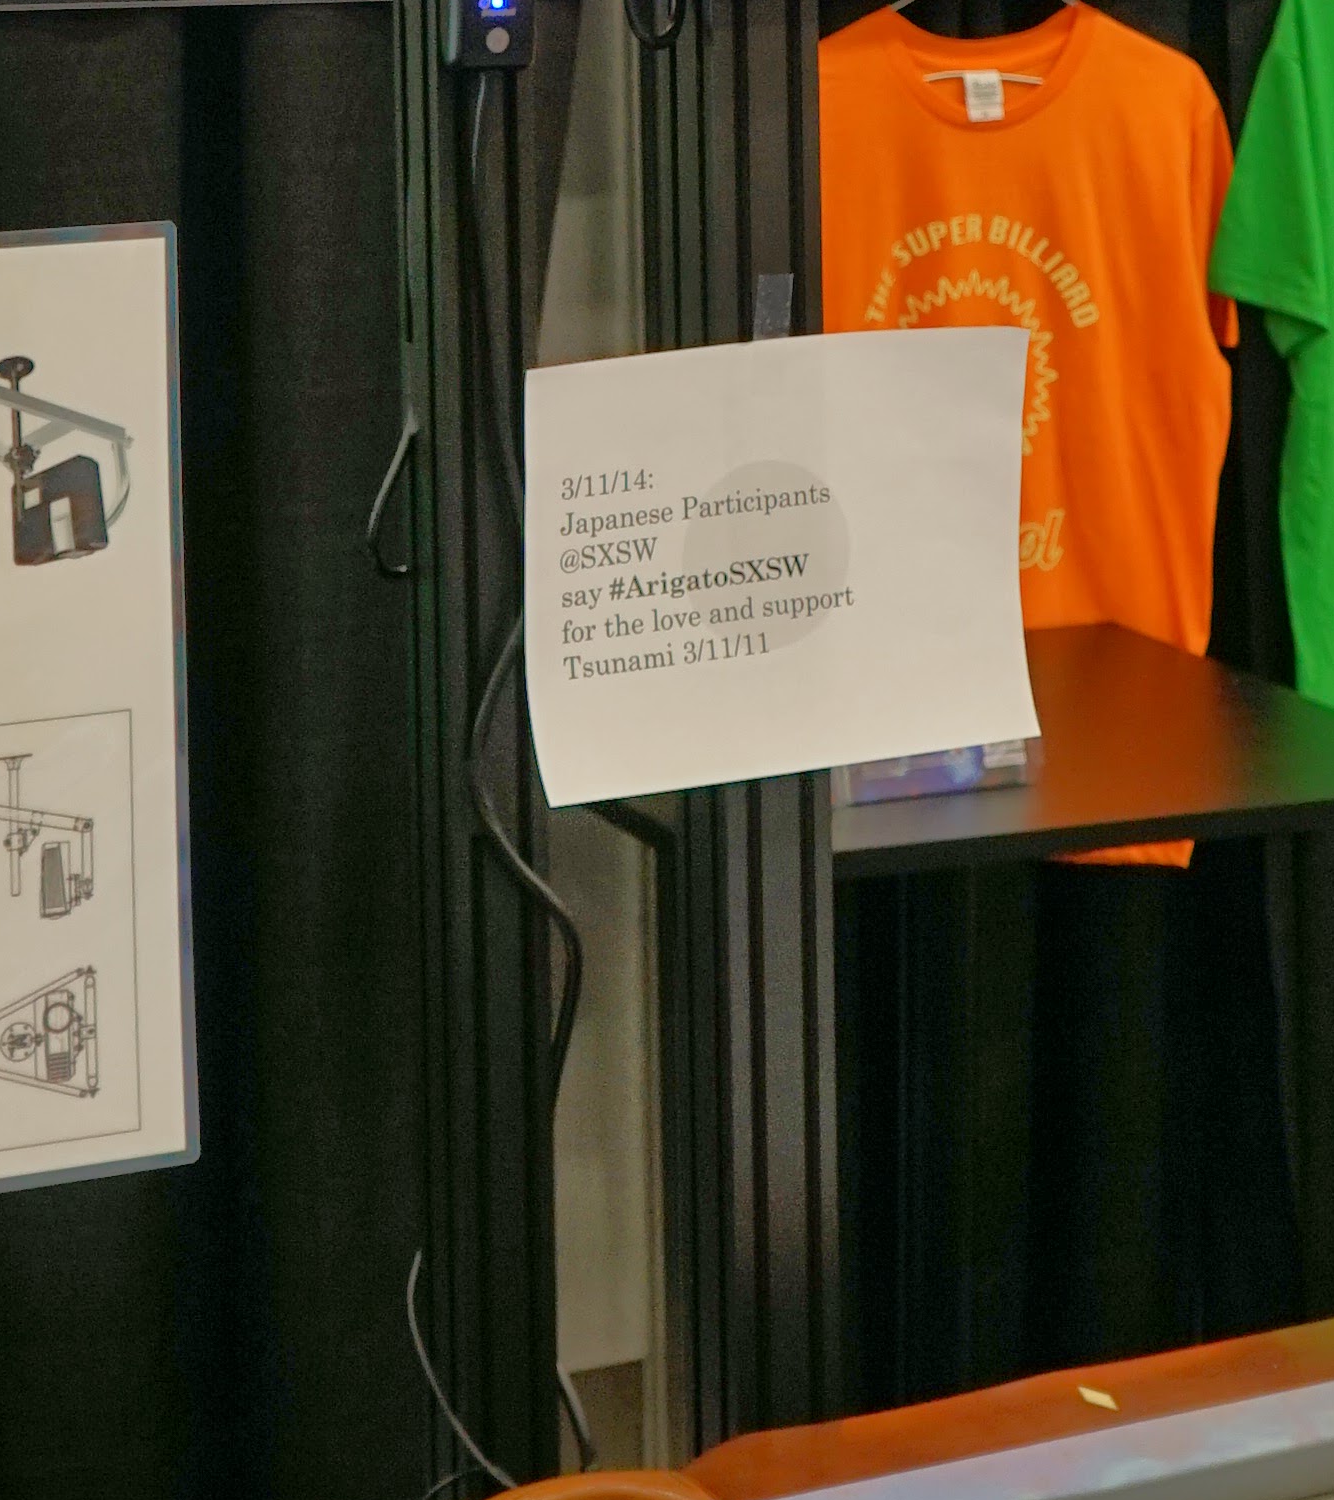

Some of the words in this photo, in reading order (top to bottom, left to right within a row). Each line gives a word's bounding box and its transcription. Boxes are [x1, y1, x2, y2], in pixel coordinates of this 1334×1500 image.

[891, 212, 983, 268] SUPER
[988, 215, 1100, 330] BILLIARD
[560, 503, 673, 538] Japanese
[682, 484, 831, 521] Participants
[561, 469, 654, 500] 3/11/14:
[560, 537, 658, 574] @SXSW
[561, 586, 602, 610] say
[609, 553, 810, 601] #ArigatoSXSW
[562, 620, 597, 644] for
[605, 614, 644, 639] the
[652, 609, 701, 633] love
[709, 597, 754, 624] and
[762, 587, 855, 619] support
[563, 643, 675, 680] Tsunami
[683, 632, 770, 664] 3/11/11
